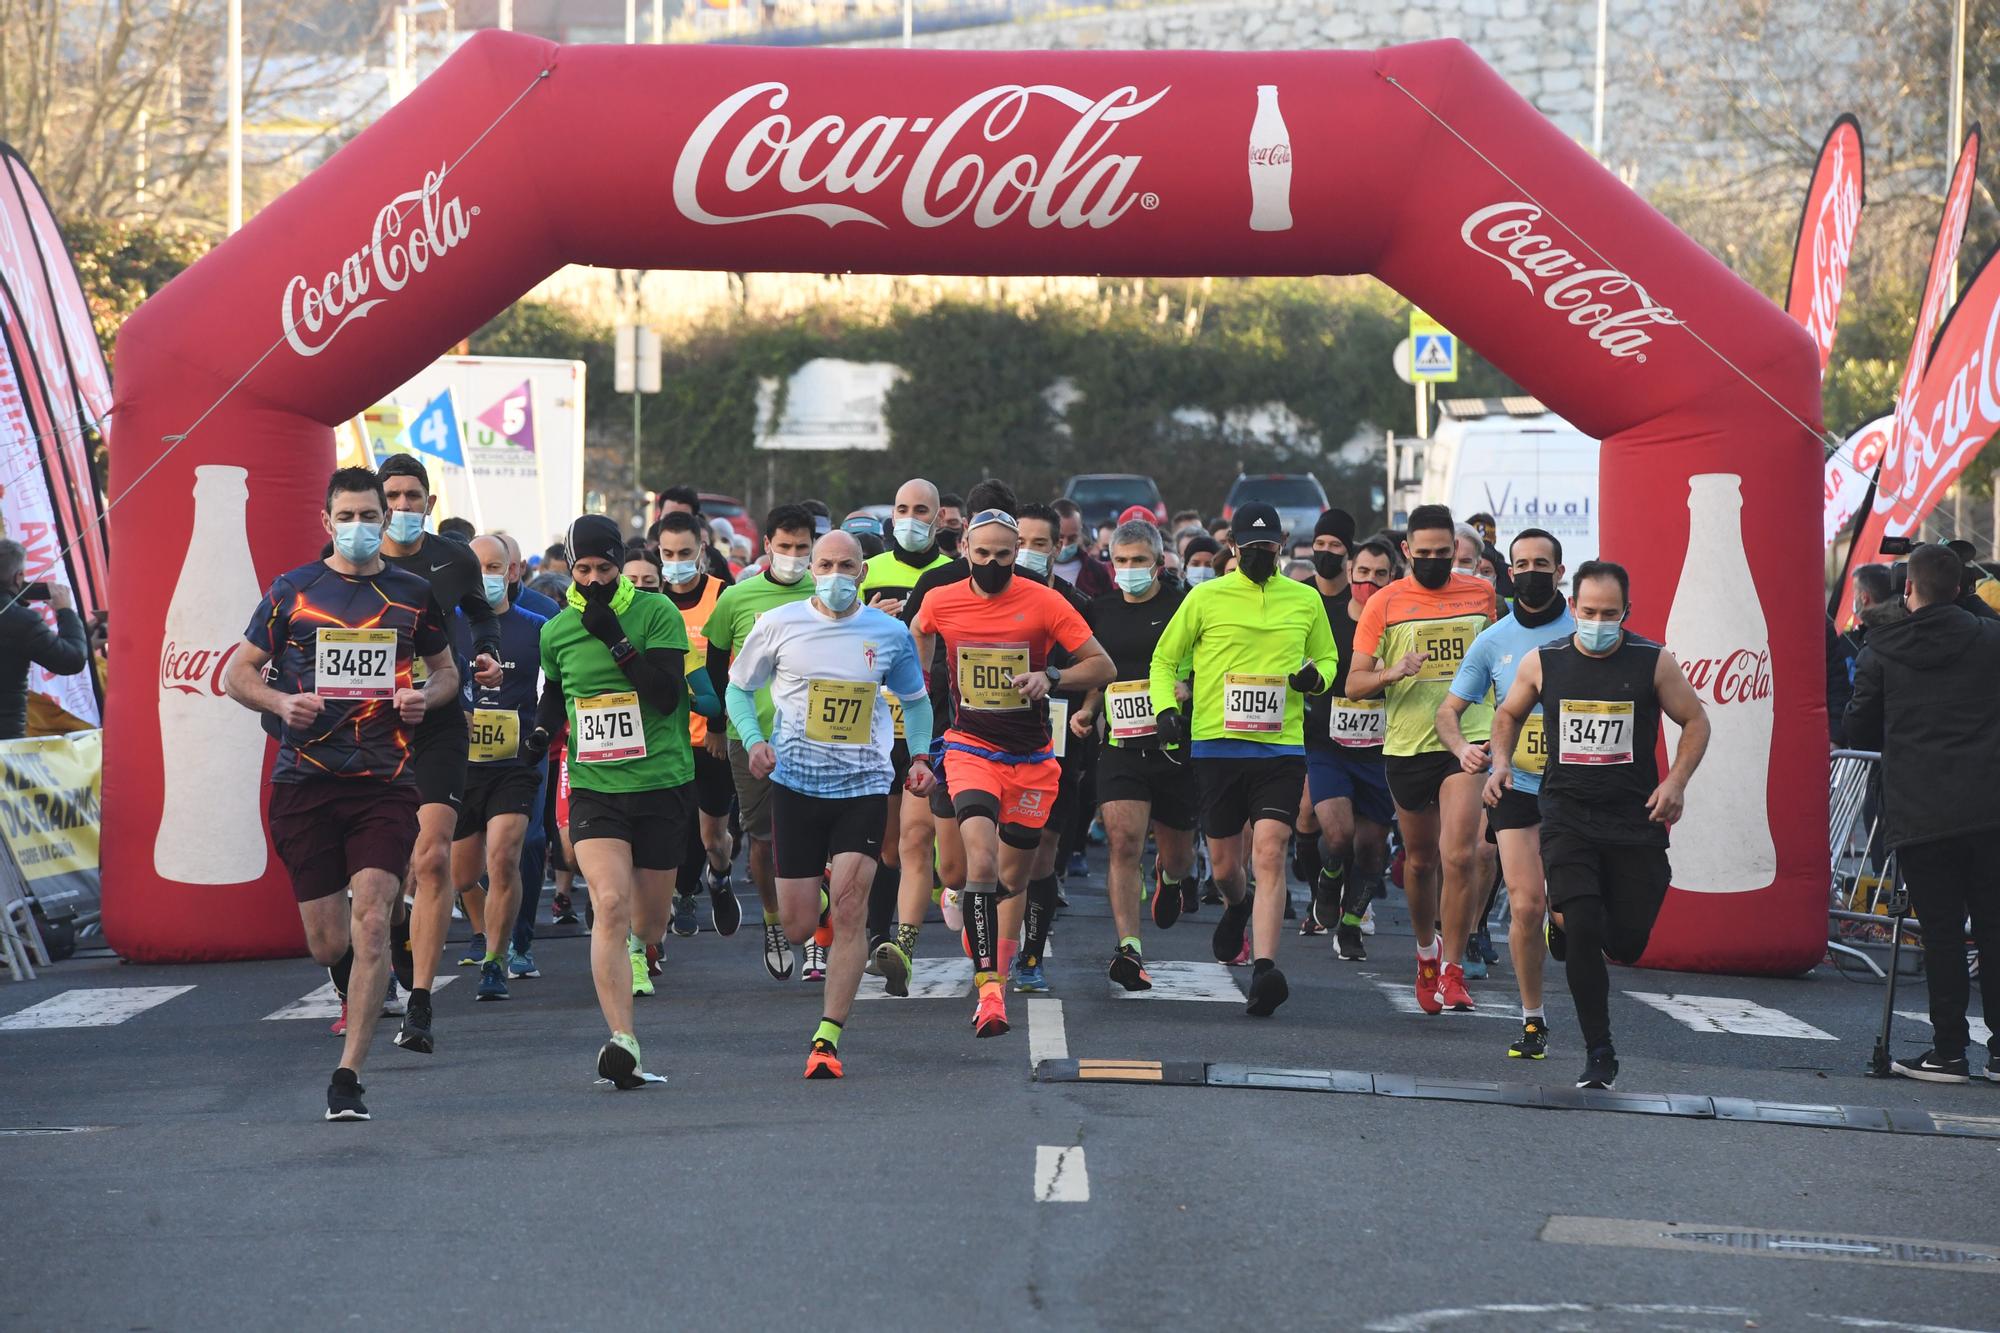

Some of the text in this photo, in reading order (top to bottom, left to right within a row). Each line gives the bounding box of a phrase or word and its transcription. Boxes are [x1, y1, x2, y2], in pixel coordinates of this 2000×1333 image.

[672, 81, 1171, 230] Coca-Cola
[282, 161, 470, 356] Coca-Cola
[1461, 202, 1687, 358] Coca-Cola
[502, 396, 527, 435] 5
[420, 409, 448, 450] 4
[1484, 481, 1589, 517] Vidual
[327, 649, 387, 676] 3482
[1427, 638, 1465, 662] 589
[973, 665, 1013, 689] 603
[822, 697, 862, 724] 577
[1231, 690, 1278, 713] 3094
[471, 724, 506, 745] 564
[584, 711, 633, 741] 3476
[1337, 712, 1379, 731] 3472
[1570, 718, 1624, 744] 3477
